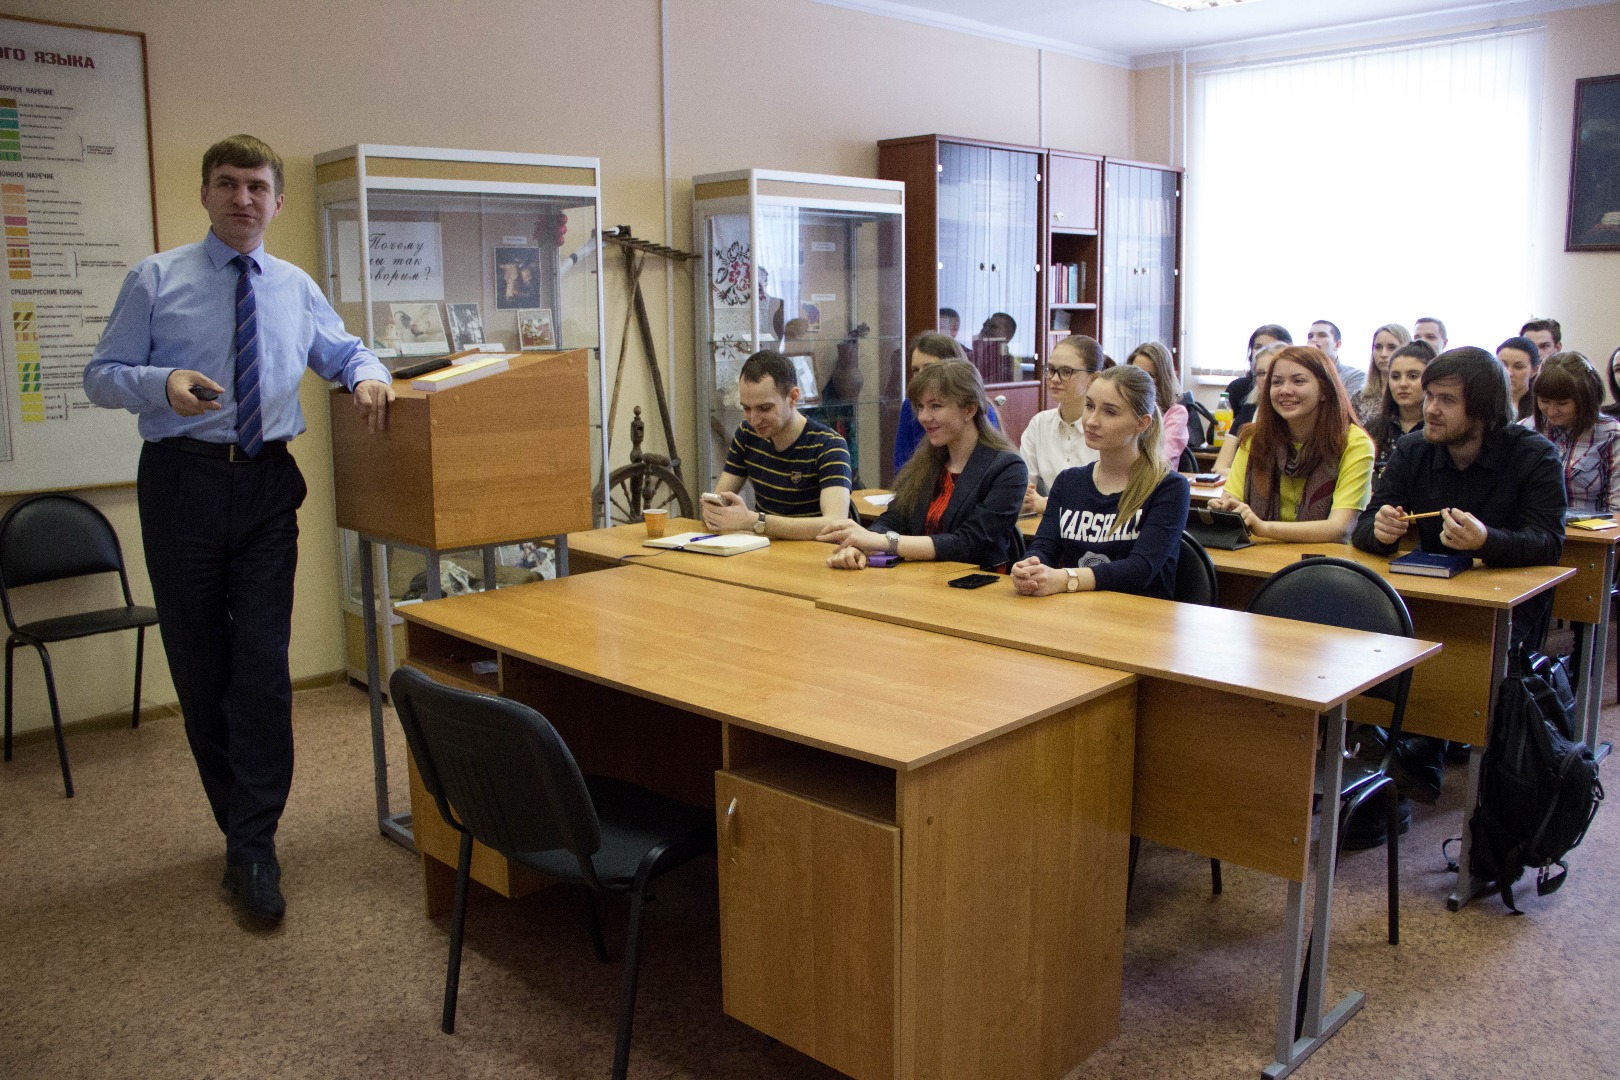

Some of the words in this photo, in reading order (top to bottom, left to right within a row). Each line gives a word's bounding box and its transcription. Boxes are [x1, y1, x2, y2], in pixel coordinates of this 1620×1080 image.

[0, 47, 26, 61] ГО
[34, 51, 95, 69] ЯЗЫКА
[26, 87, 53, 95] НАРЕЧИЕ
[27, 171, 54, 179] НАРЕЧИЕ
[368, 233, 424, 256] Почему
